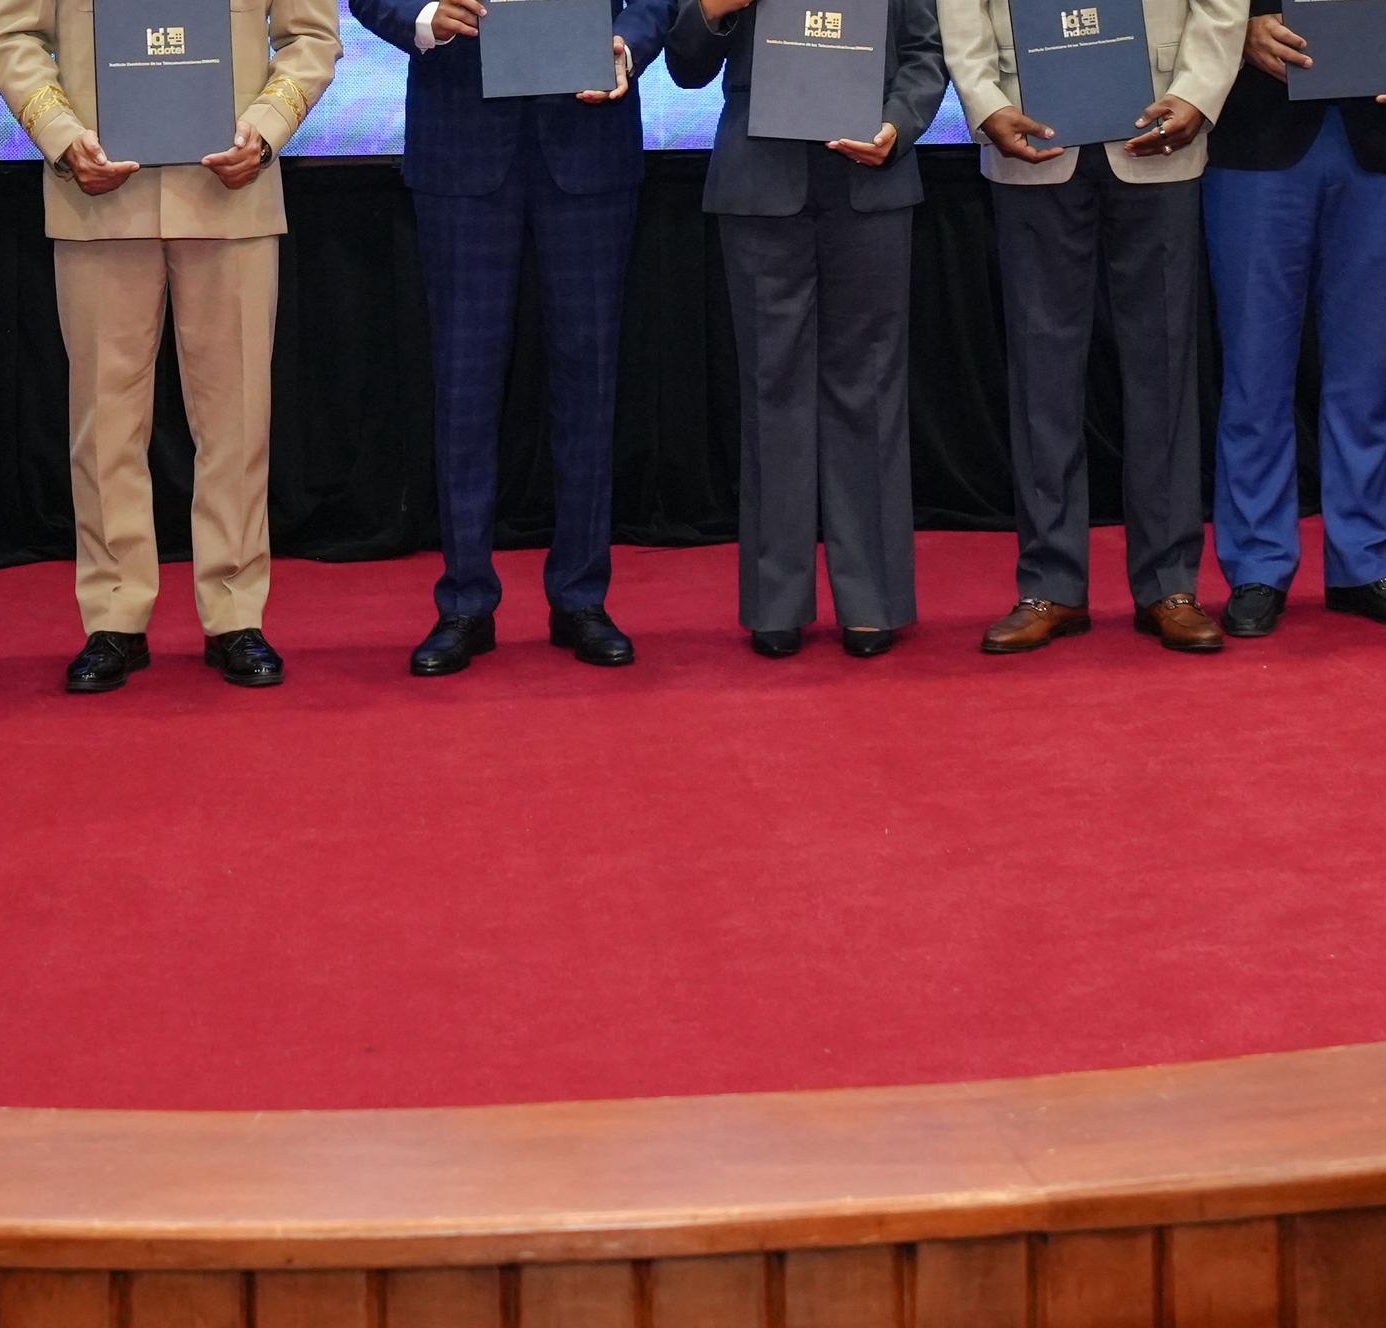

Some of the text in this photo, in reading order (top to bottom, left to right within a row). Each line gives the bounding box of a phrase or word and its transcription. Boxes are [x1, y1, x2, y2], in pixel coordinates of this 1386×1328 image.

[804, 27, 841, 39] indotel
[1063, 26, 1101, 39] indotel
[147, 45, 185, 55] indotel
